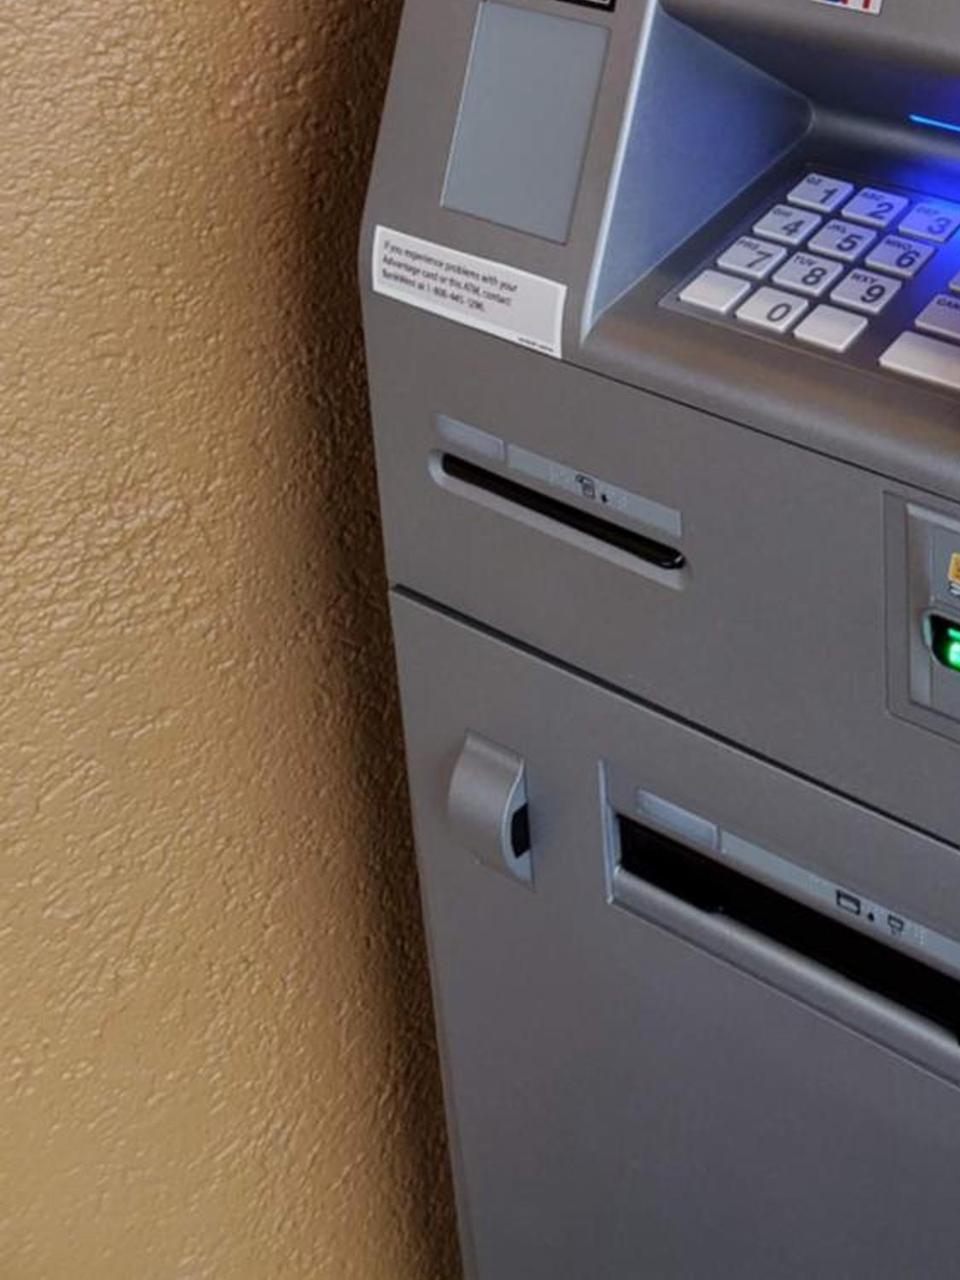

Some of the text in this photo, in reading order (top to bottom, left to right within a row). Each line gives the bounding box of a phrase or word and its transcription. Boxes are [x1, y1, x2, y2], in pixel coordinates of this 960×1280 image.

[820, 187, 839, 205] 1
[867, 202, 895, 220] 2
[781, 219, 805, 236] 4
[927, 217, 952, 235] 3
[836, 233, 864, 252] 5
[745, 250, 775, 268] 7
[895, 250, 920, 269] 6
[800, 266, 827, 286] 8
[860, 283, 887, 304] 9
[766, 302, 793, 322] 0
